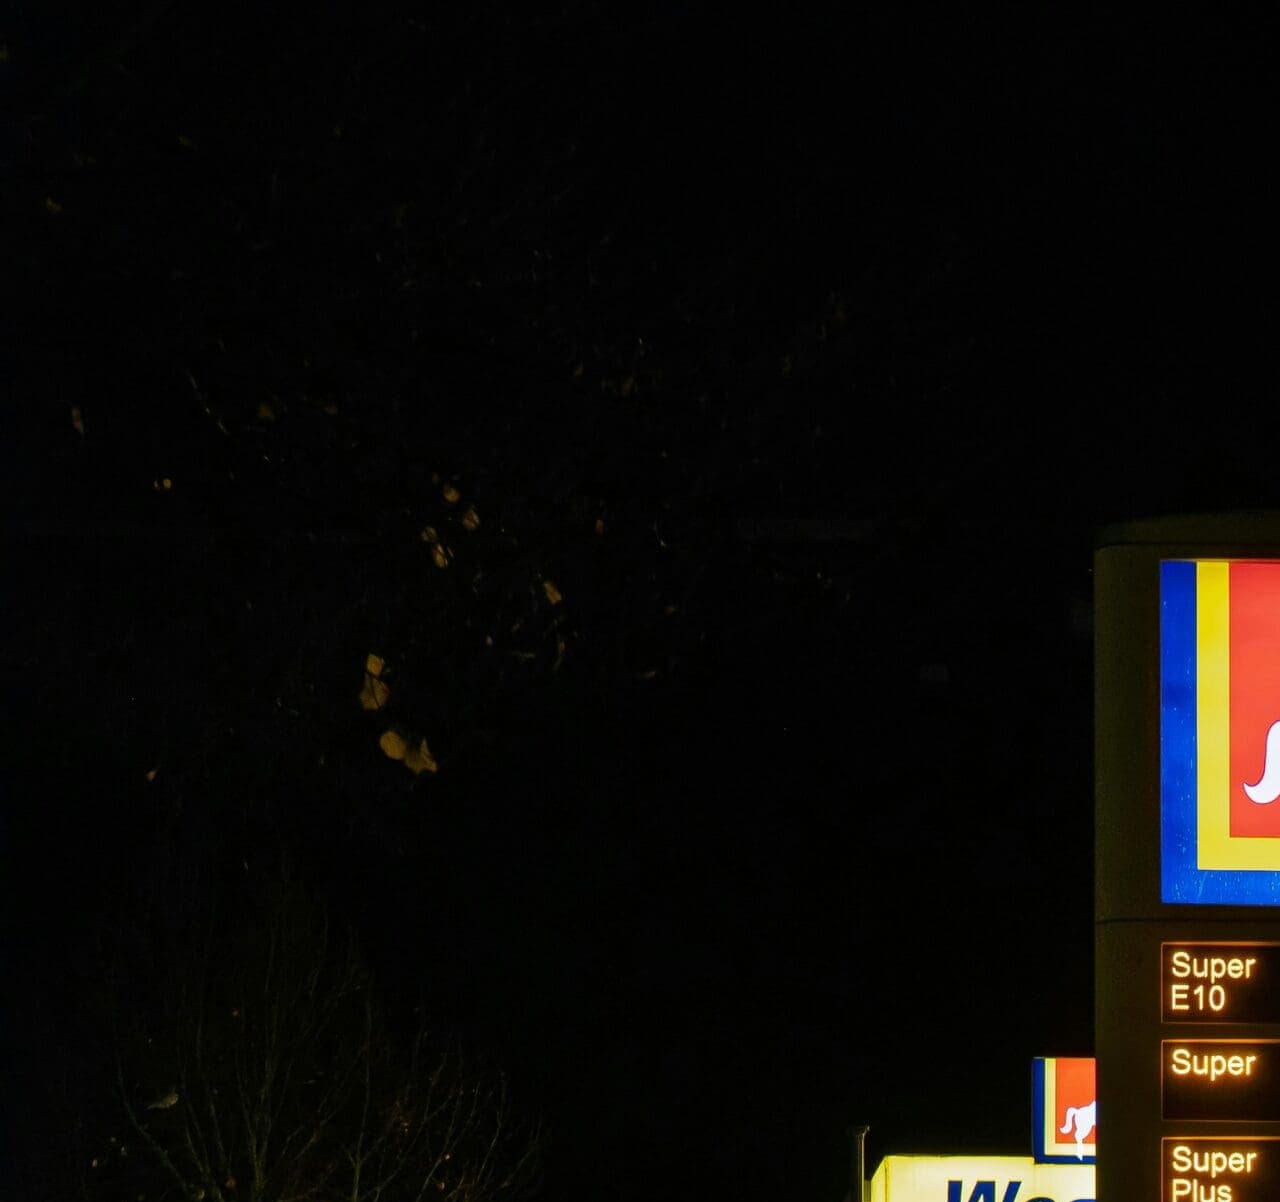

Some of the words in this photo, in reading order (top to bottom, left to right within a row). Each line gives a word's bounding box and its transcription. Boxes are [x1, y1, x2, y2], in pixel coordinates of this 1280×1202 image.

[1171, 952, 1257, 983] Super
[1171, 985, 1226, 1011] E10
[1171, 1049, 1257, 1081] Super
[1172, 1146, 1258, 1178] Super
